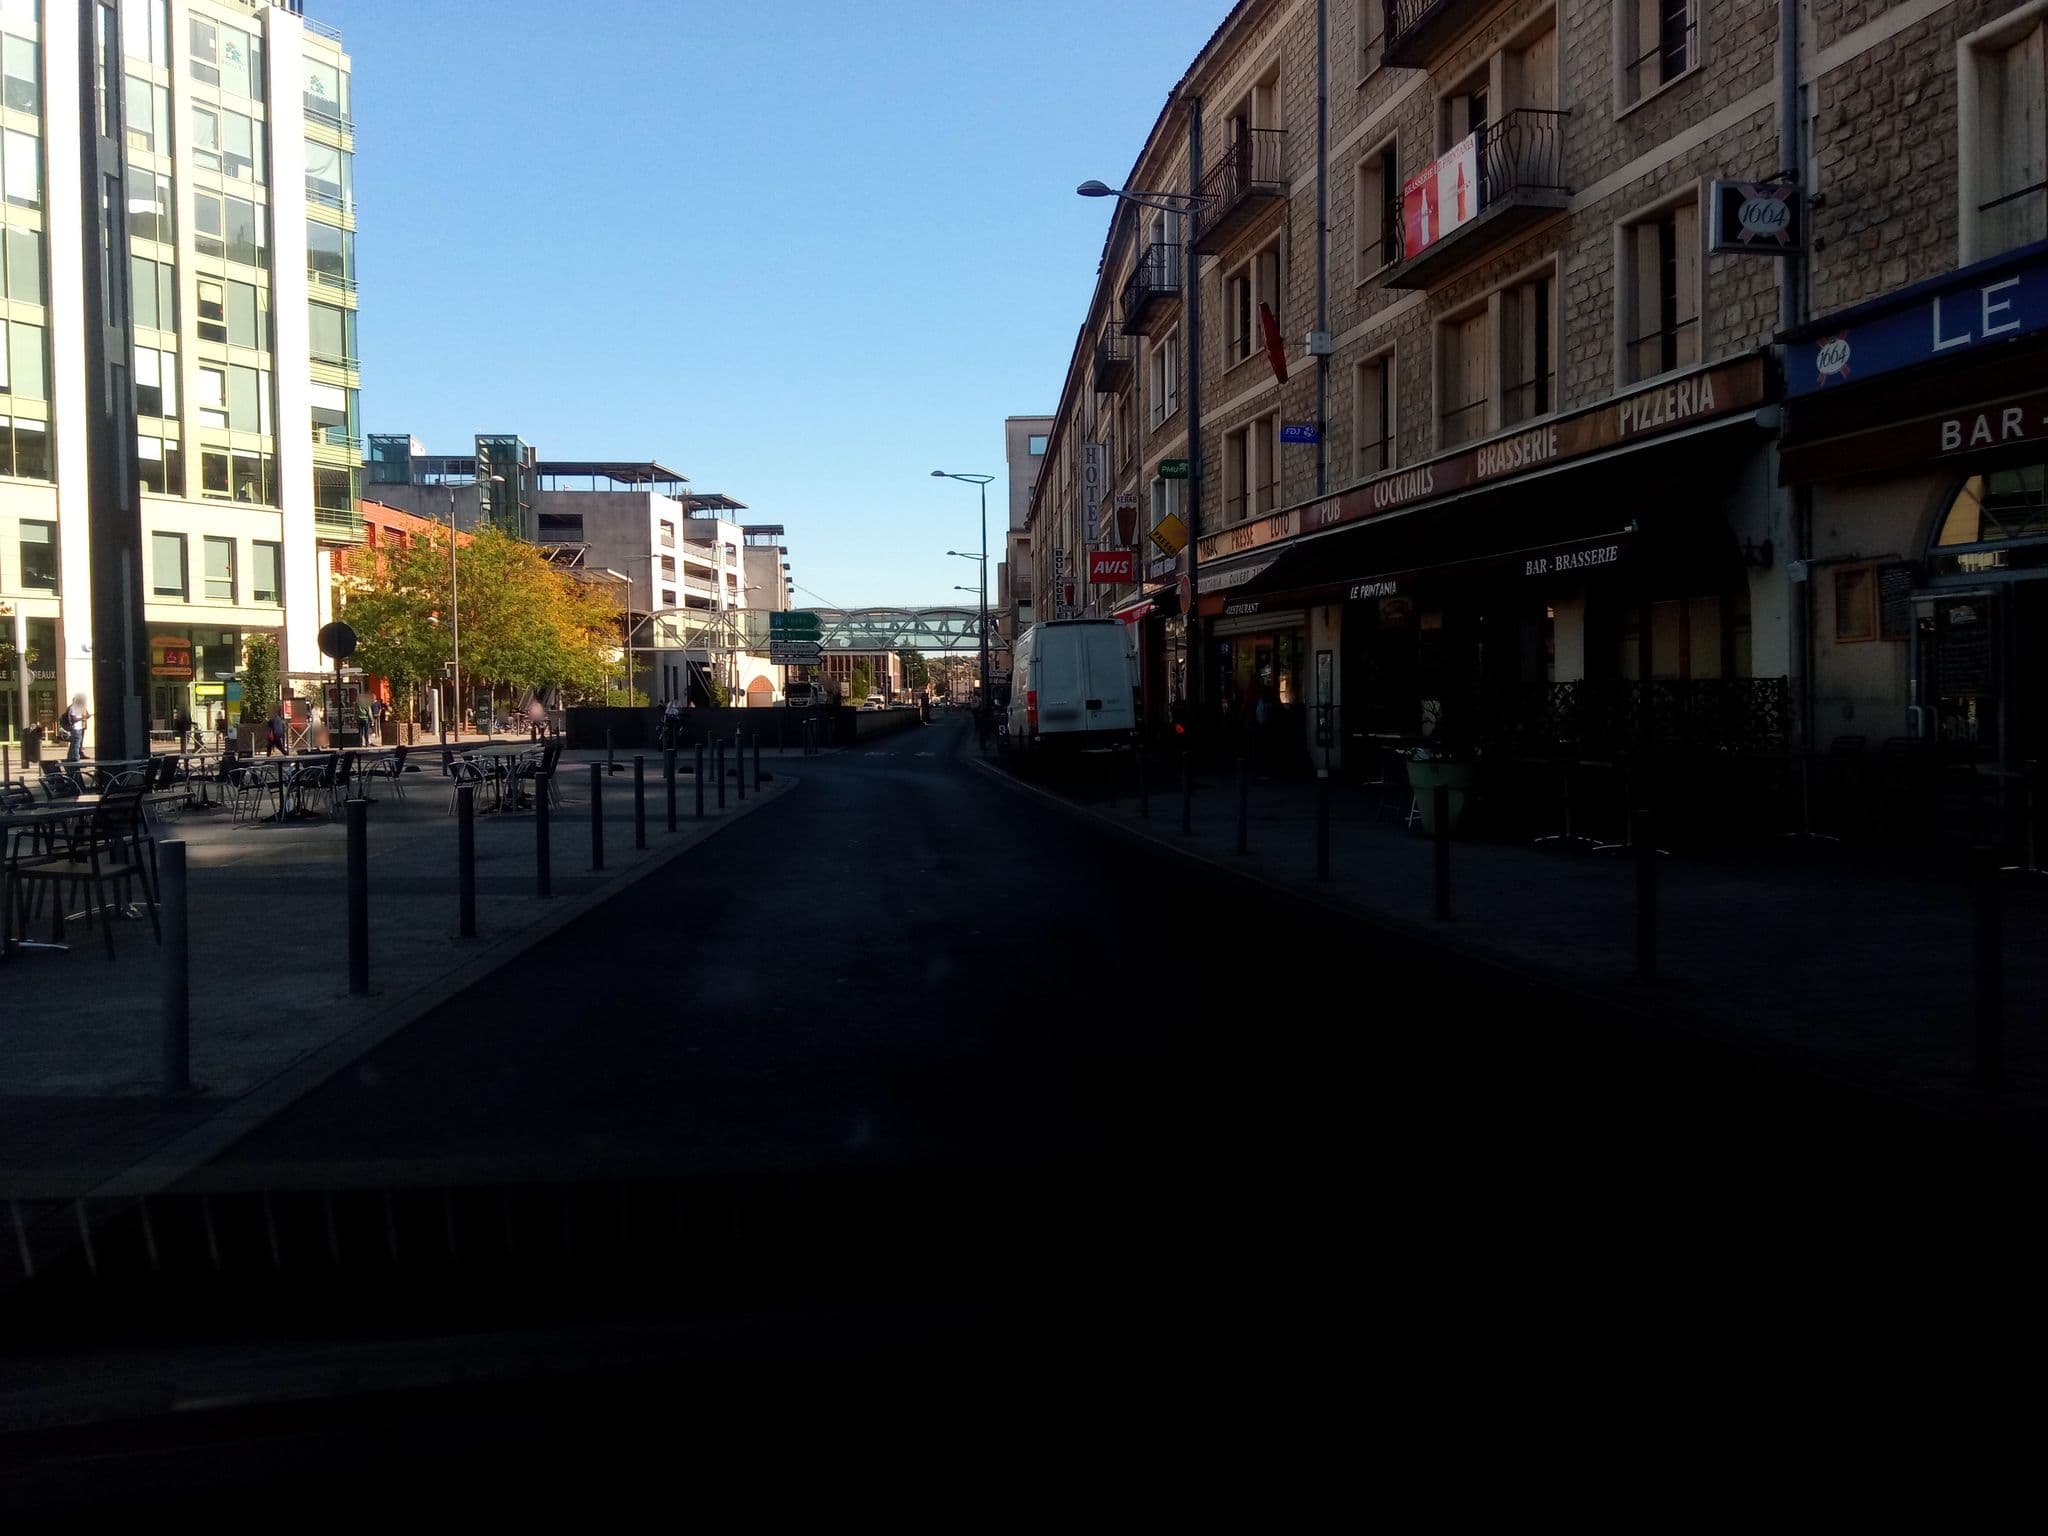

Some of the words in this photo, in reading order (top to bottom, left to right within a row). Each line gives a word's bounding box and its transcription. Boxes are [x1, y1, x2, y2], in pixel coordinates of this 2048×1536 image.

[1742, 202, 1786, 227] 1664
[1931, 275, 2021, 352] LE
[1820, 345, 1848, 368] 1664
[1285, 427, 1301, 436] FDJ
[1941, 407, 2025, 451] BAR
[1231, 525, 1254, 551] PRESSE
[1270, 512, 1290, 539] LOTO
[1321, 497, 1341, 524] PUB
[1374, 465, 1434, 508] COCKTAILS
[1477, 424, 1558, 478] BRASSERIE
[1618, 373, 1715, 436] PIZZERIA
[1085, 447, 1099, 542] HOTEL
[1116, 495, 1138, 504] KEBAB
[1153, 530, 1177, 555] PRESSE
[1093, 560, 1130, 574] AVIS
[1526, 559, 1547, 575] BAR
[1555, 546, 1618, 571] BRASSERIE
[1350, 586, 1360, 599] LE
[1360, 580, 1397, 600] PRINTANIA
